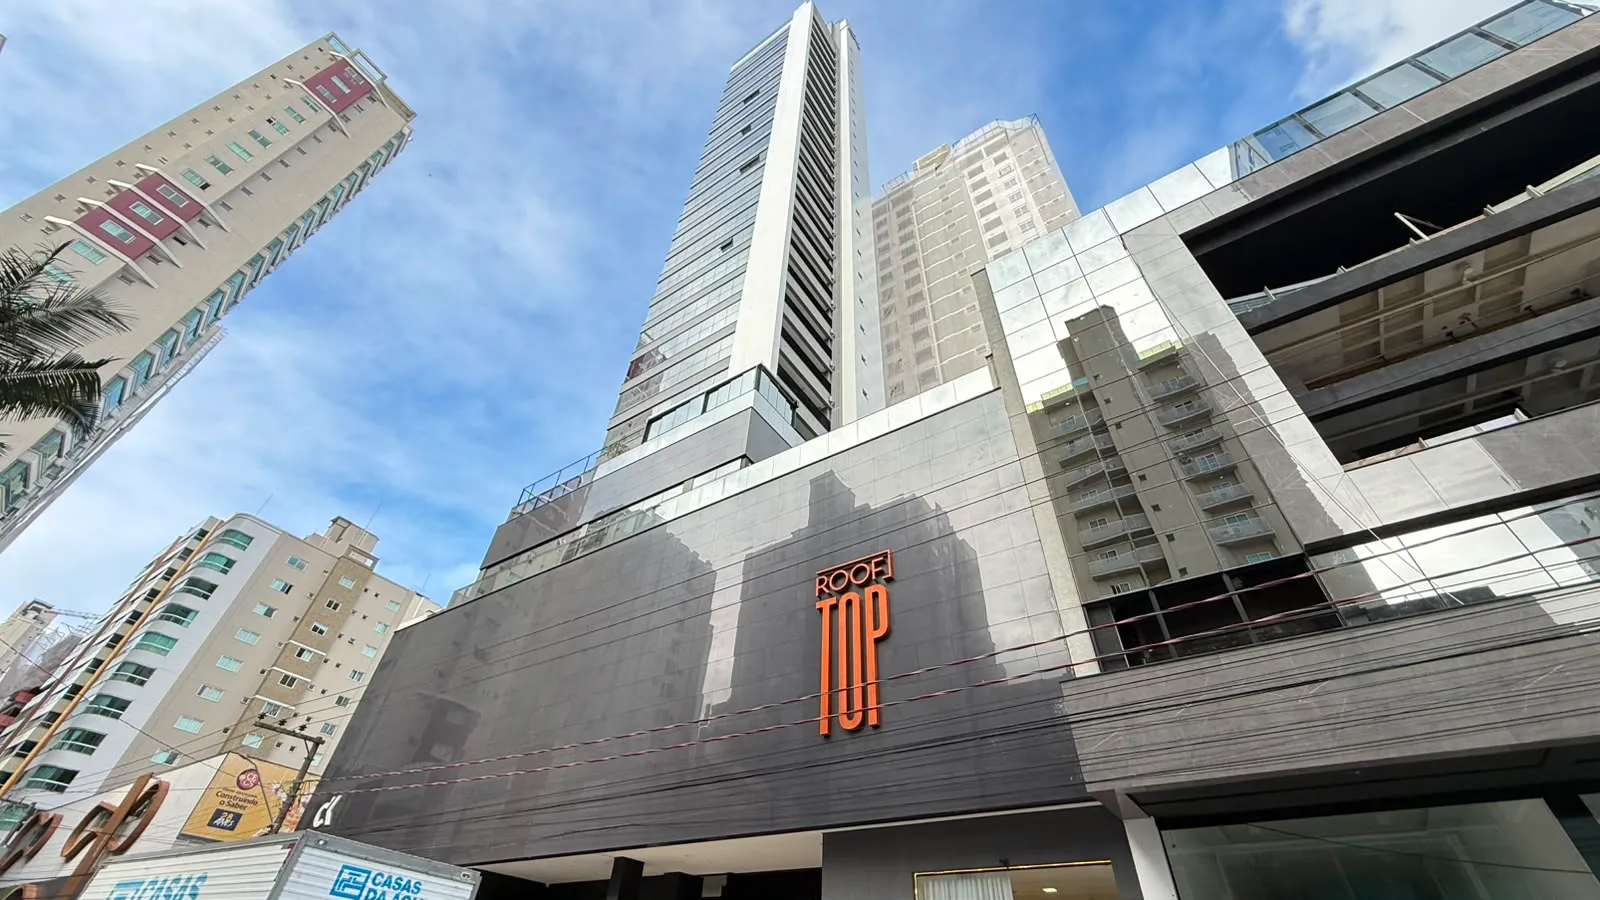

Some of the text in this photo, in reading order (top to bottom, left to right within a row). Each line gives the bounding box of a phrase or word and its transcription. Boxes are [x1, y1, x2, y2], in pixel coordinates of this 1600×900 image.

[815, 555, 886, 598] ROOF
[815, 584, 890, 736] TOP
[216, 790, 259, 806] Construindo
[225, 800, 248, 811] Saber
[371, 871, 422, 895] CASAS
